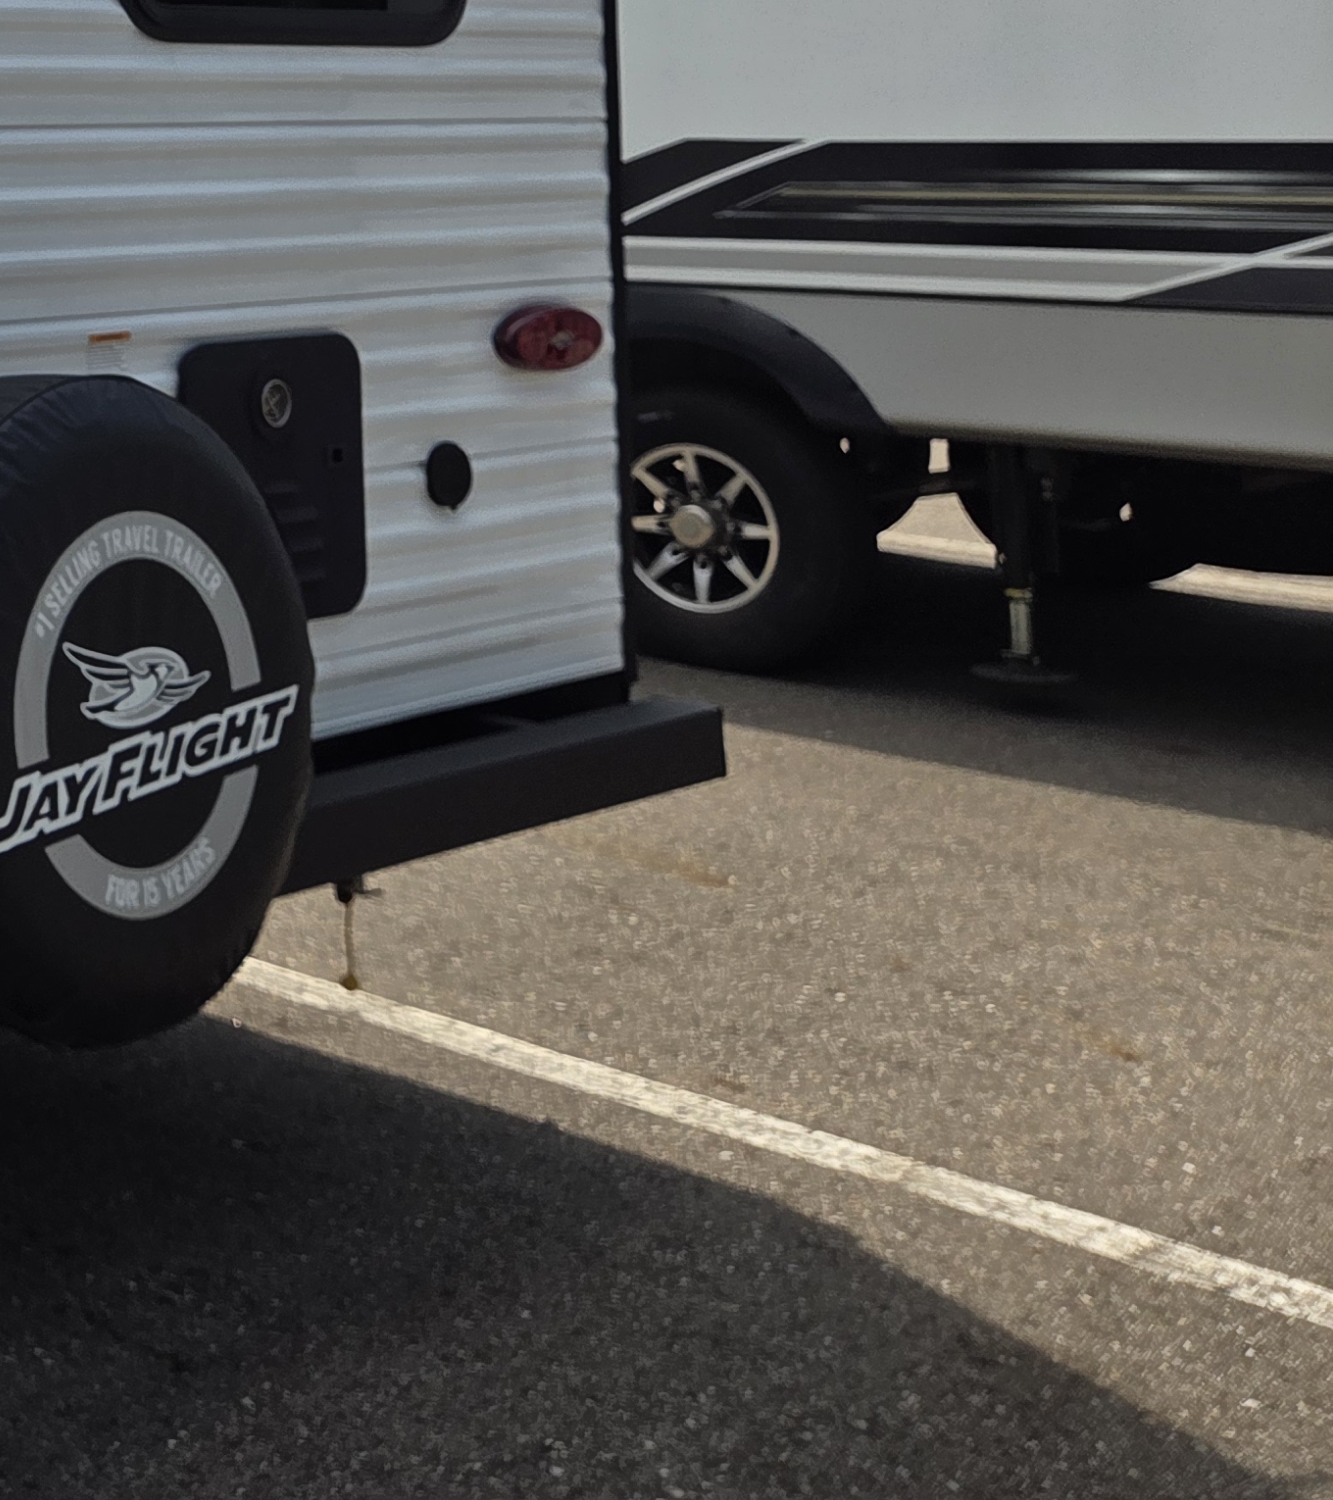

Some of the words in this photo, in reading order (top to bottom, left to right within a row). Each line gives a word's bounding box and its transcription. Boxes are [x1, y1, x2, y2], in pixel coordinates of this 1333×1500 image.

[43, 540, 102, 618] SELLING
[100, 524, 160, 559] TRAVEL
[163, 529, 223, 599] TRAILER
[105, 873, 141, 909] FOR
[160, 836, 218, 900] YEARS
